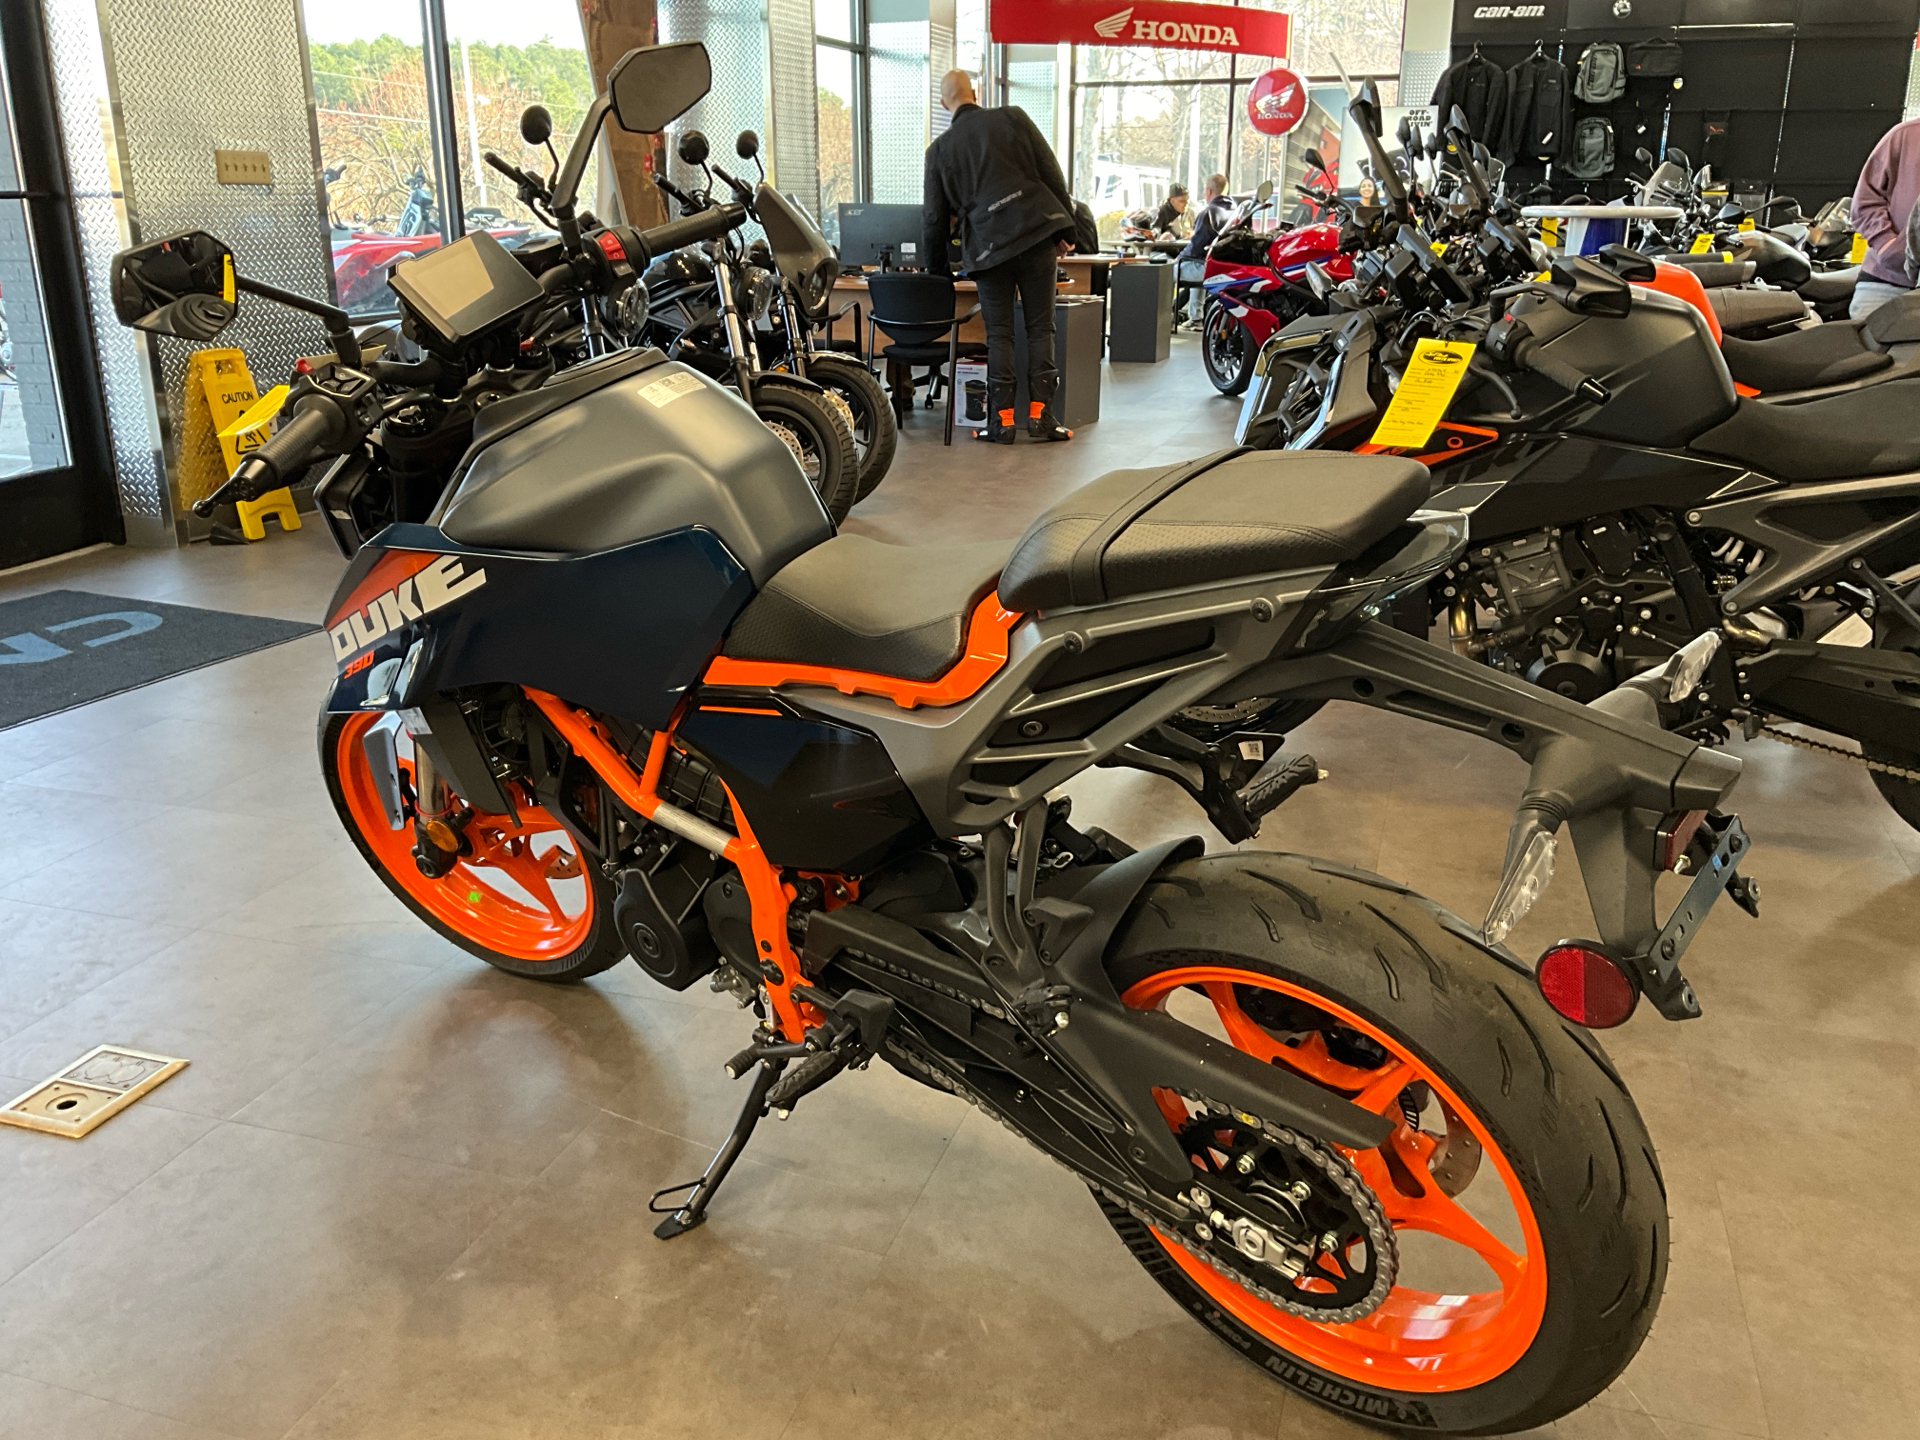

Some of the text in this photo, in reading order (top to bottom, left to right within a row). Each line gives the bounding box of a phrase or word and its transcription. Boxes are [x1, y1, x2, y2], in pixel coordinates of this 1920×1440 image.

[1474, 5, 1546, 18] can-am
[1132, 19, 1240, 46] HONDA
[1257, 111, 1294, 120] HONDA
[221, 390, 254, 404] CAUTION
[329, 554, 487, 663] DUKE
[344, 650, 375, 680] 390
[1264, 1355, 1390, 1417] MICHELIN
